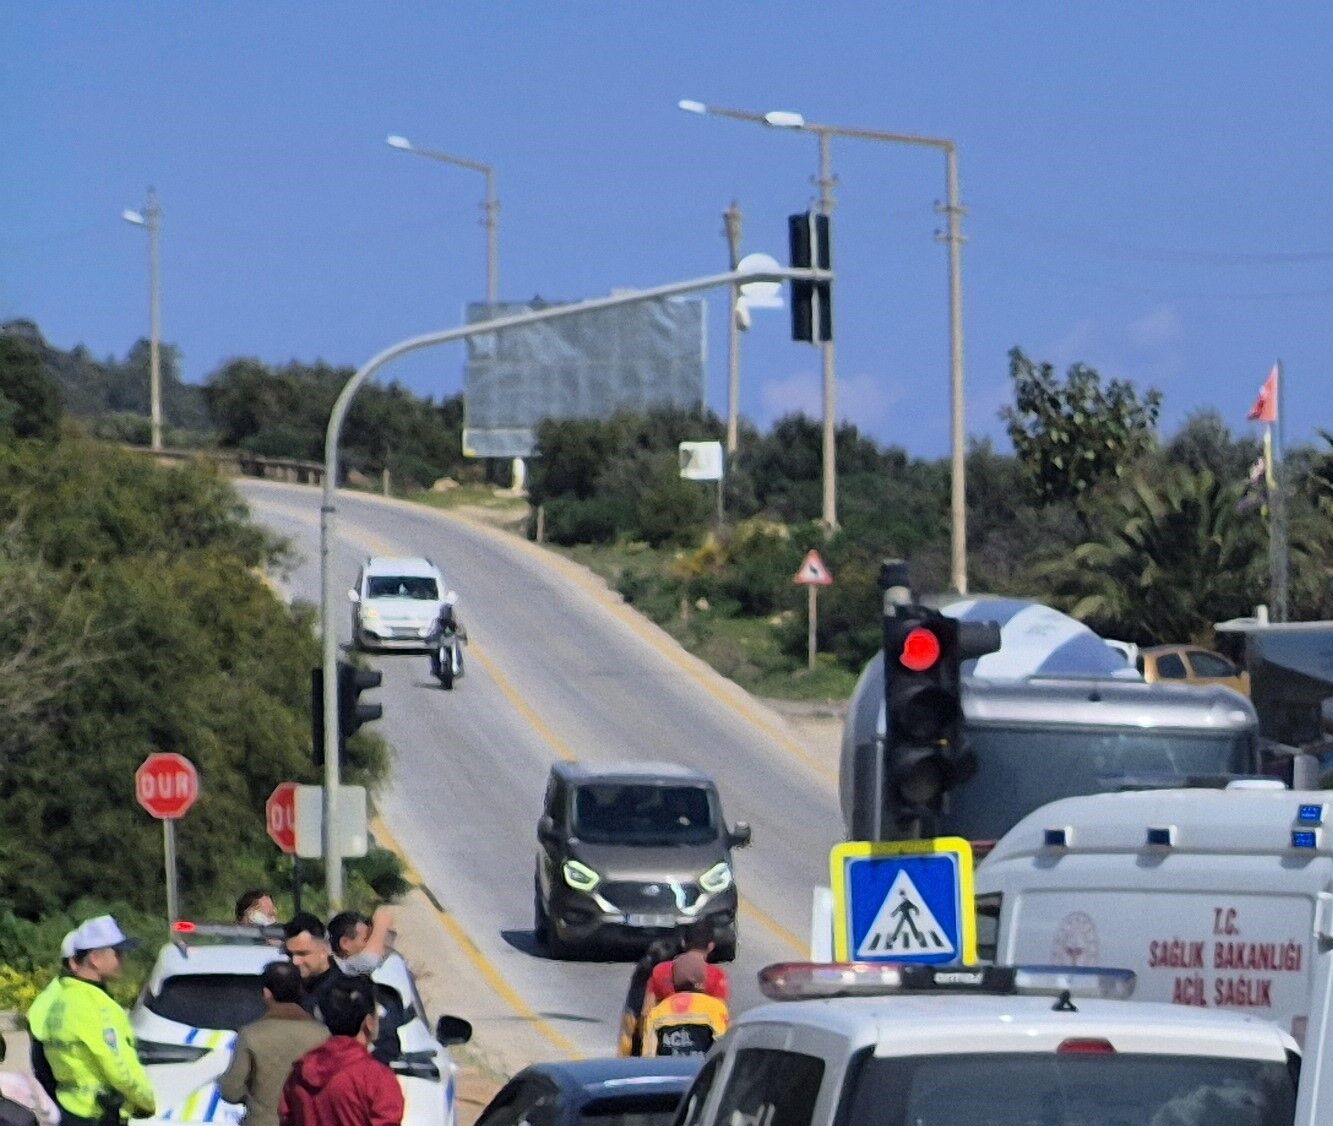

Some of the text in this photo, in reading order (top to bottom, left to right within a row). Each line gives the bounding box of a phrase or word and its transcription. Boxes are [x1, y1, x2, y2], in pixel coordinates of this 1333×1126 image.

[140, 771, 190, 800] DUR
[1213, 907, 1239, 936] T.C.
[1149, 936, 1302, 972] SAĞLIK BAKANLIĞI
[1173, 973, 1272, 1008] ACİL SAĞLIK
